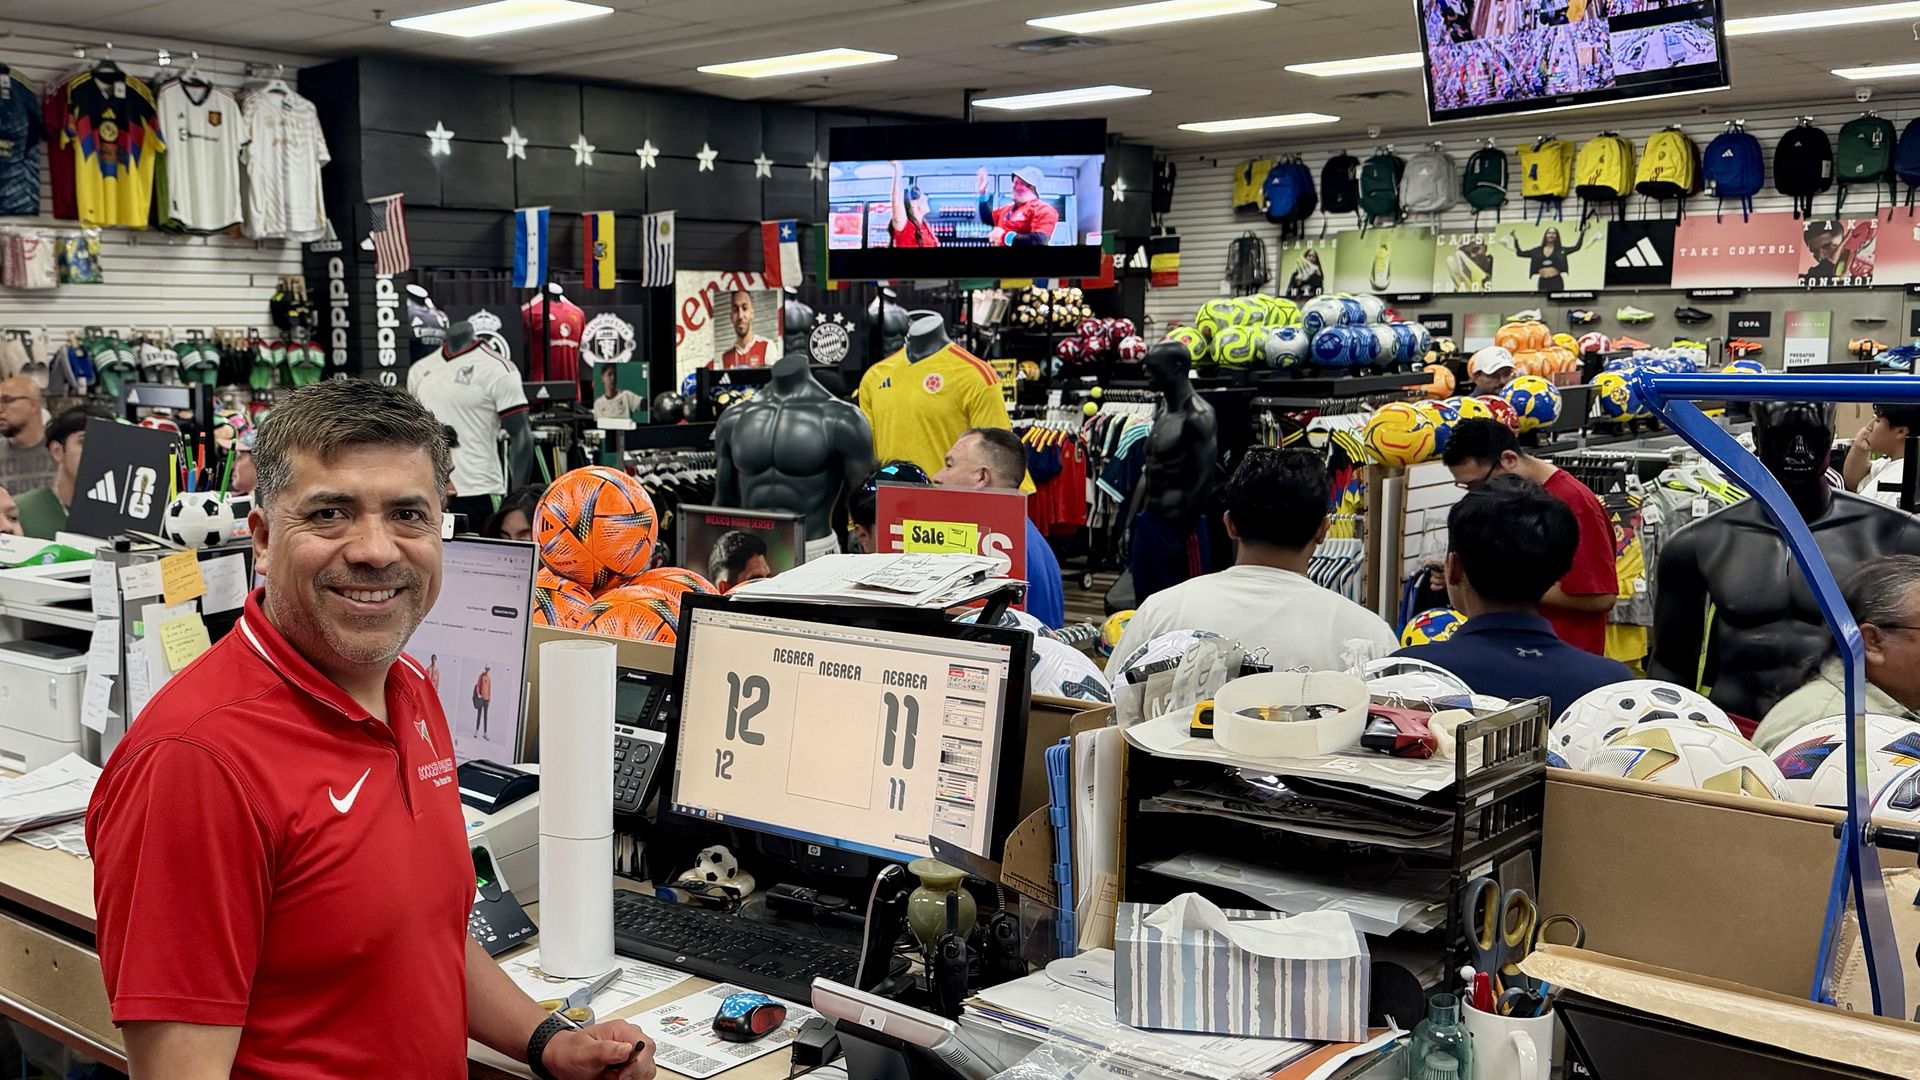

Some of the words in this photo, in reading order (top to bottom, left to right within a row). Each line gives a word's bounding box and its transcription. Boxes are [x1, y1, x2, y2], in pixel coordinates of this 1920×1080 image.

[1802, 217, 1878, 231] TAKE
[1436, 232, 1497, 246] CAUSE
[1680, 247, 1719, 257] TAKE
[1729, 244, 1795, 256] CONTROL
[1798, 275, 1873, 287] CONTROL
[328, 256, 349, 366] adidas
[375, 274, 400, 366] didas
[1738, 320, 1760, 328] COPA
[911, 525, 945, 546] Sale
[725, 671, 771, 746] 12
[882, 691, 920, 770] 11
[715, 748, 735, 780] 12
[889, 777, 906, 811] 11
